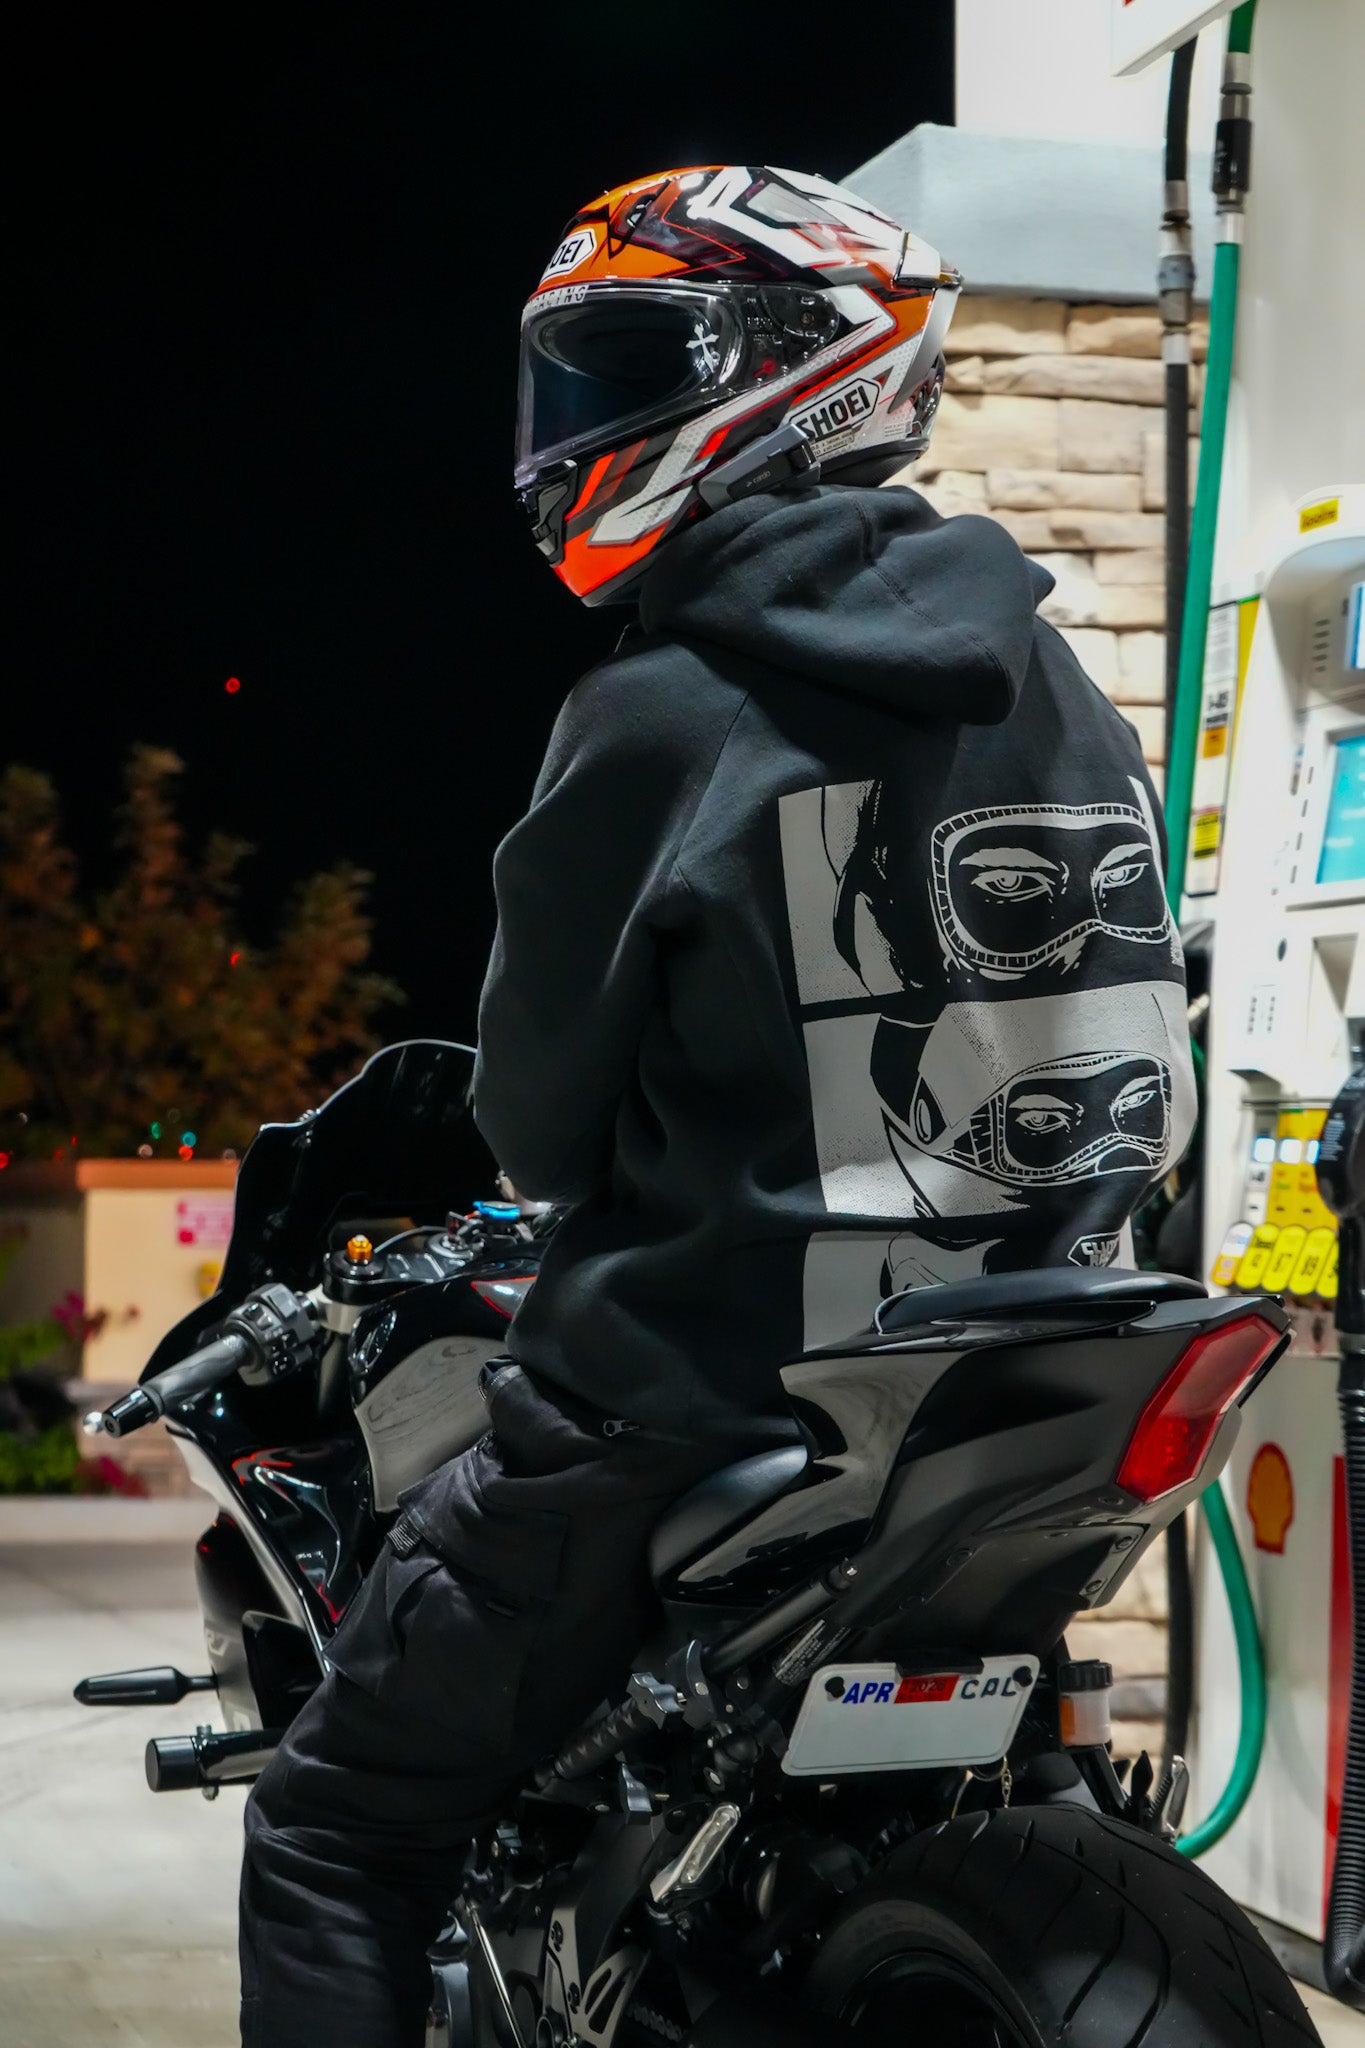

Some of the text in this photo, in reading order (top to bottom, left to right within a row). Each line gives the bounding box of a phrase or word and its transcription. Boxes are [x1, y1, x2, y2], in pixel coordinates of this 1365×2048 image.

[550, 239, 585, 269] OEI
[797, 385, 871, 441] SHOEI
[842, 1682, 894, 1704] APR
[960, 1677, 1017, 1700] CAL
